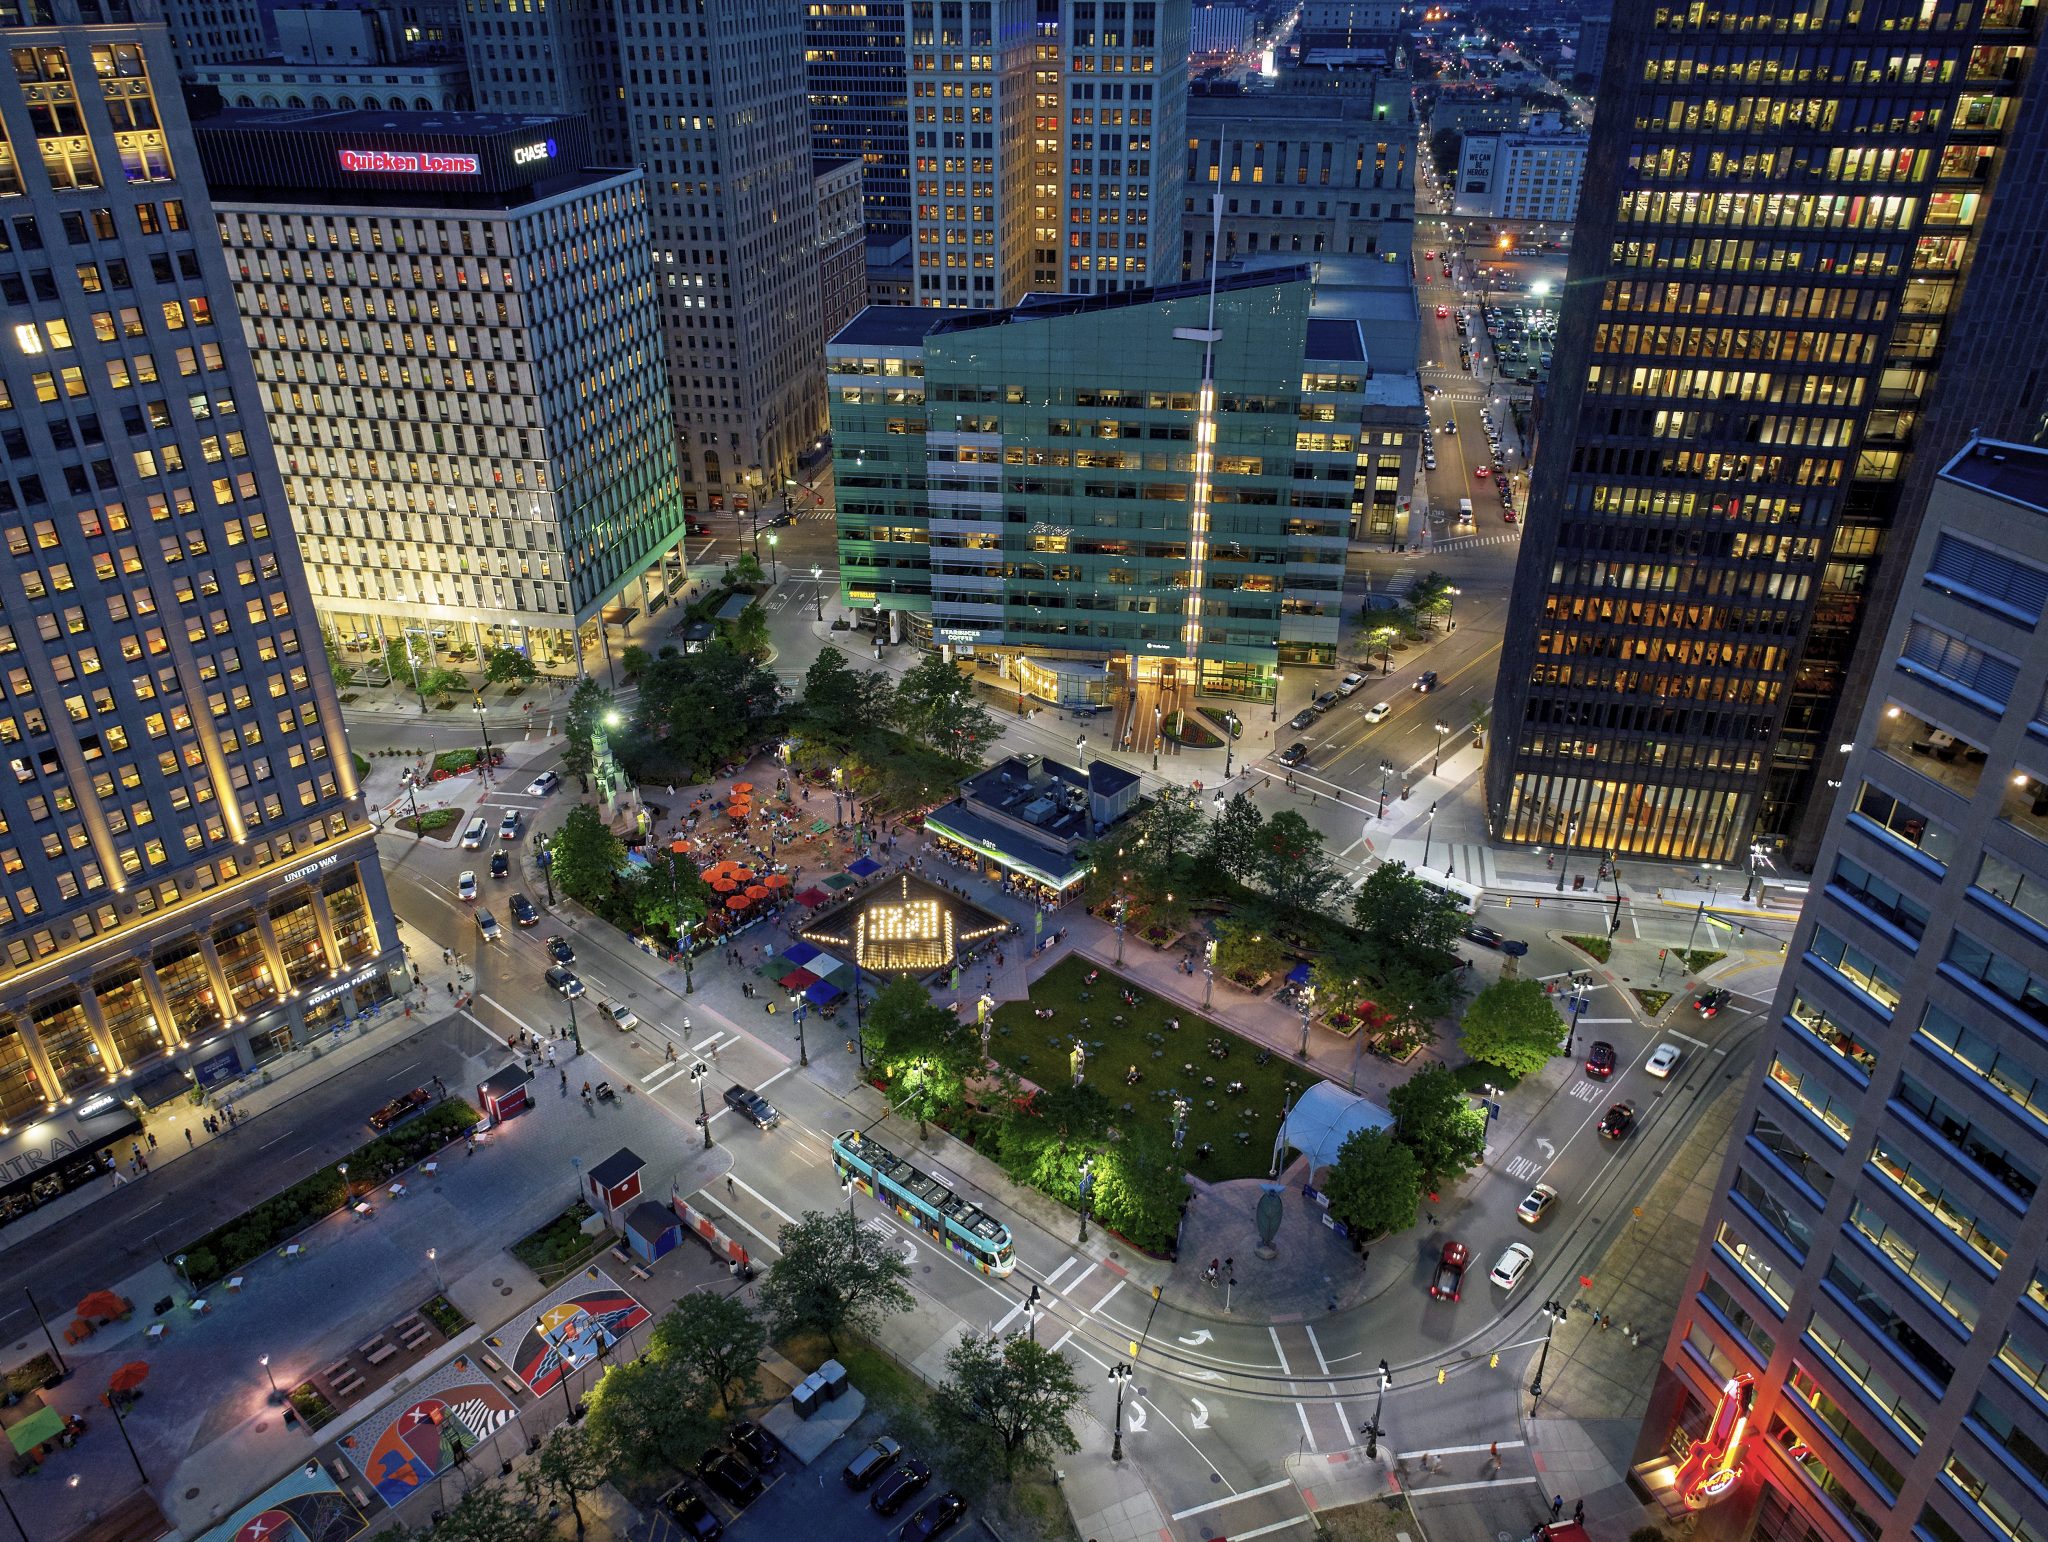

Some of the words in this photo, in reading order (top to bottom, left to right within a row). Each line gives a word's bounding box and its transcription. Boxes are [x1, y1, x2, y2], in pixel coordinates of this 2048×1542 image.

[341, 151, 417, 171] Quicken
[420, 153, 477, 172] Loans
[514, 142, 548, 165] CHASE
[1469, 153, 1479, 161] WE
[1479, 153, 1491, 161] CAN
[1466, 168, 1489, 176] HEROES
[1475, 161, 1484, 169] BE
[940, 629, 981, 637] STARBUCKS
[947, 634, 974, 642] COFFEE
[284, 863, 319, 883] UNITED
[318, 854, 338, 869] WAY
[308, 981, 351, 1006] ROASTING
[351, 969, 377, 986] PLANT
[1569, 1080, 1604, 1104] ONLY
[1505, 1155, 1542, 1182] ONLY
[861, 1216, 898, 1248] ONL
